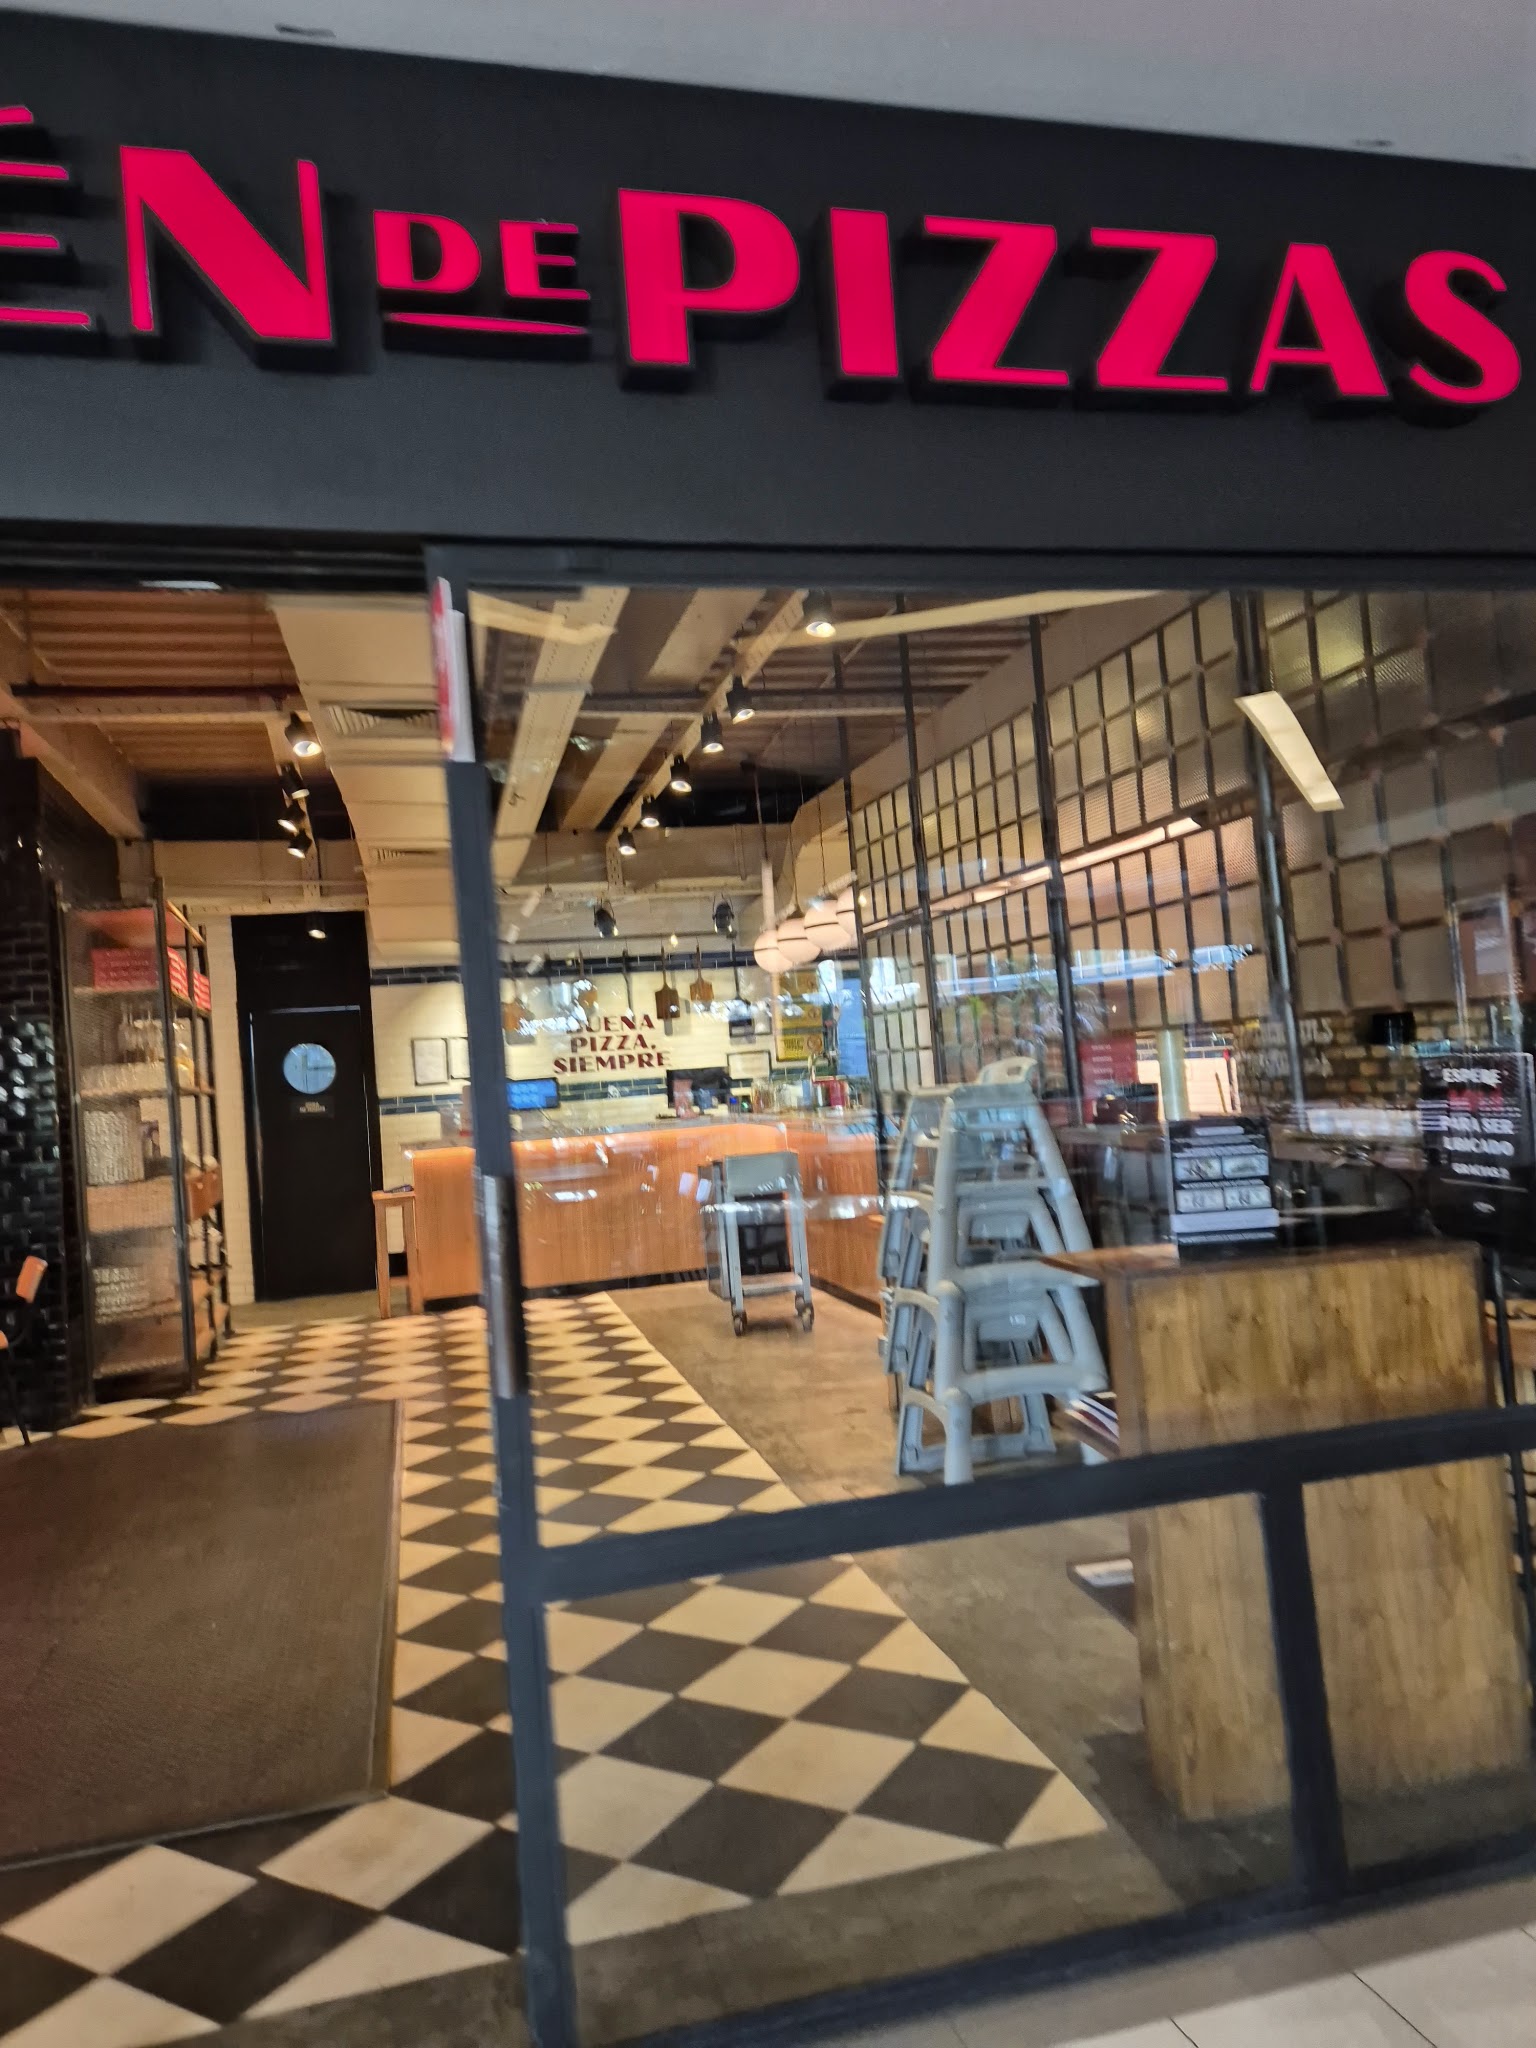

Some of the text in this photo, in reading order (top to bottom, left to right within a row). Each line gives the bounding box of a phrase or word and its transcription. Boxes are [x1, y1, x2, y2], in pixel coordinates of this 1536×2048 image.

[374, 211, 588, 299] DE
[620, 190, 1520, 403] PIZZAS
[567, 1014, 655, 1034] UENA
[553, 1051, 671, 1074] SIEMPRE
